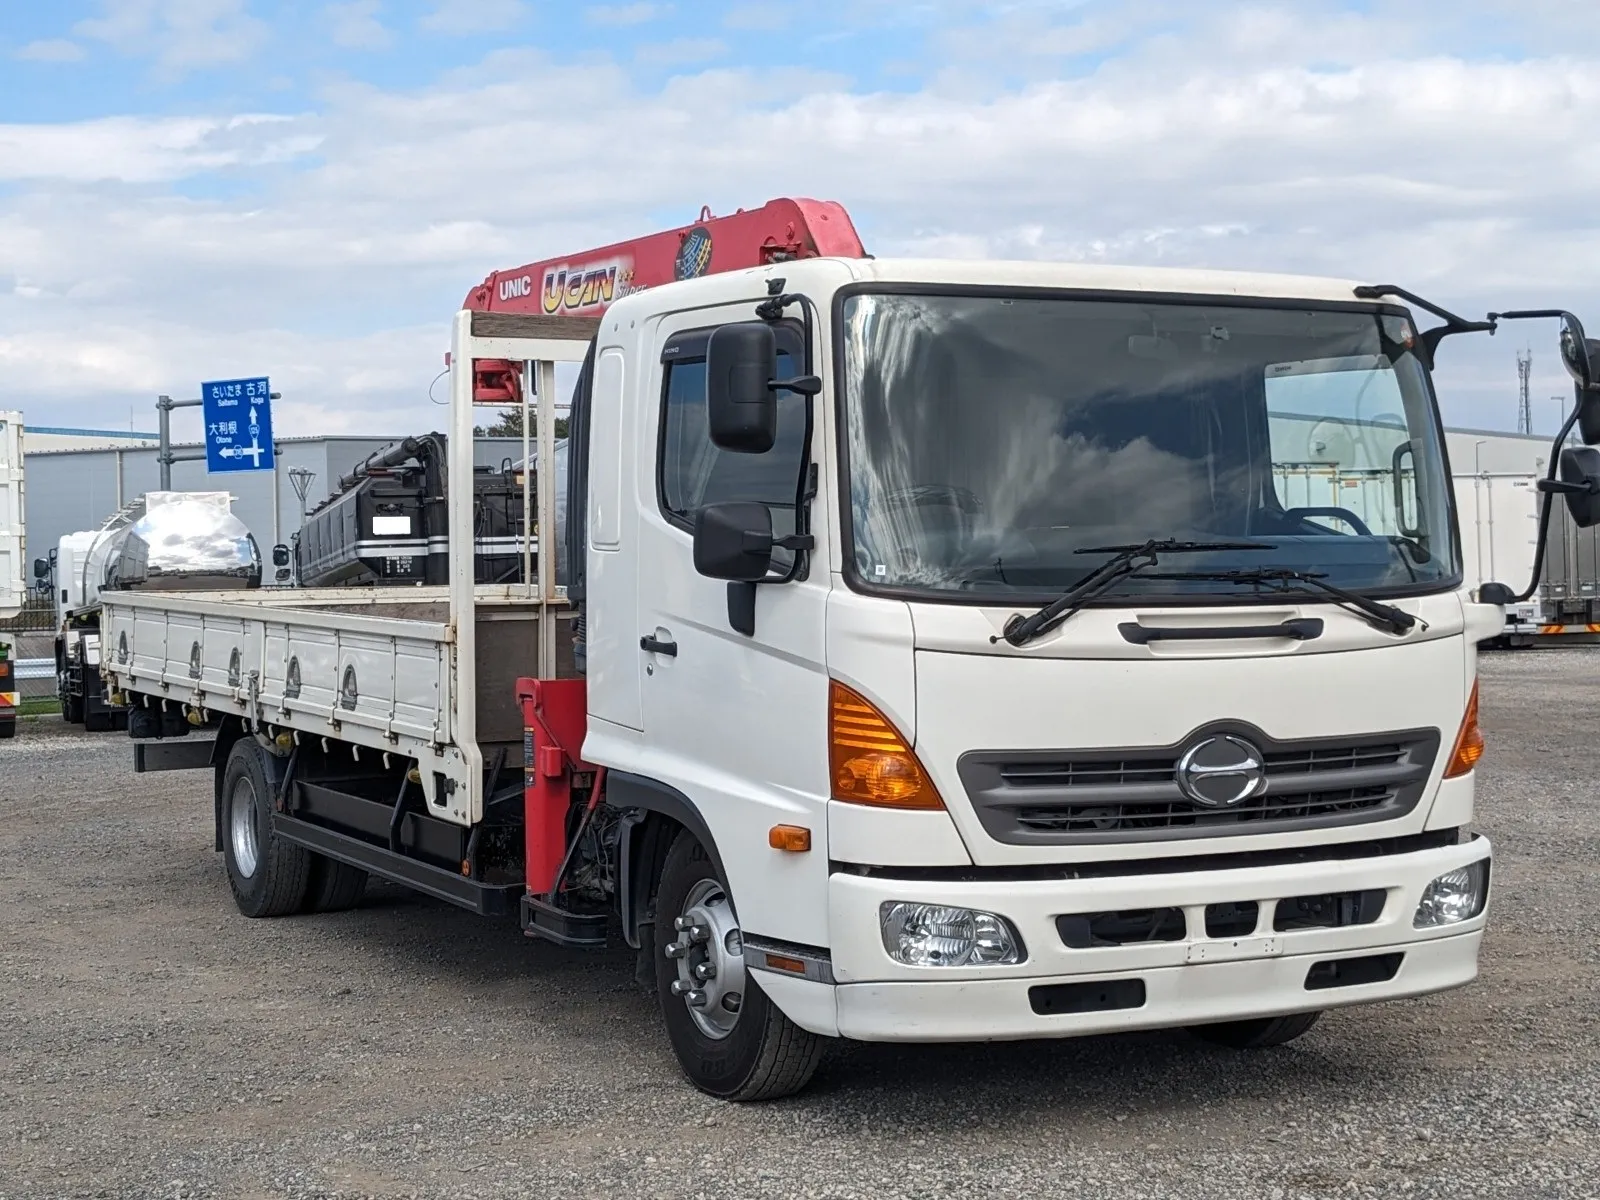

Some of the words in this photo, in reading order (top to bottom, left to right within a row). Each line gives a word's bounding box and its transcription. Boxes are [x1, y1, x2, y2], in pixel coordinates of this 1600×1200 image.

[499, 275, 531, 301] UNIC
[543, 266, 616, 314] UCAN
[212, 384, 242, 399] さいたま
[246, 381, 267, 396] 古河
[217, 399, 239, 407] Saitama
[250, 397, 265, 405] Koga
[209, 421, 238, 436] 大利根
